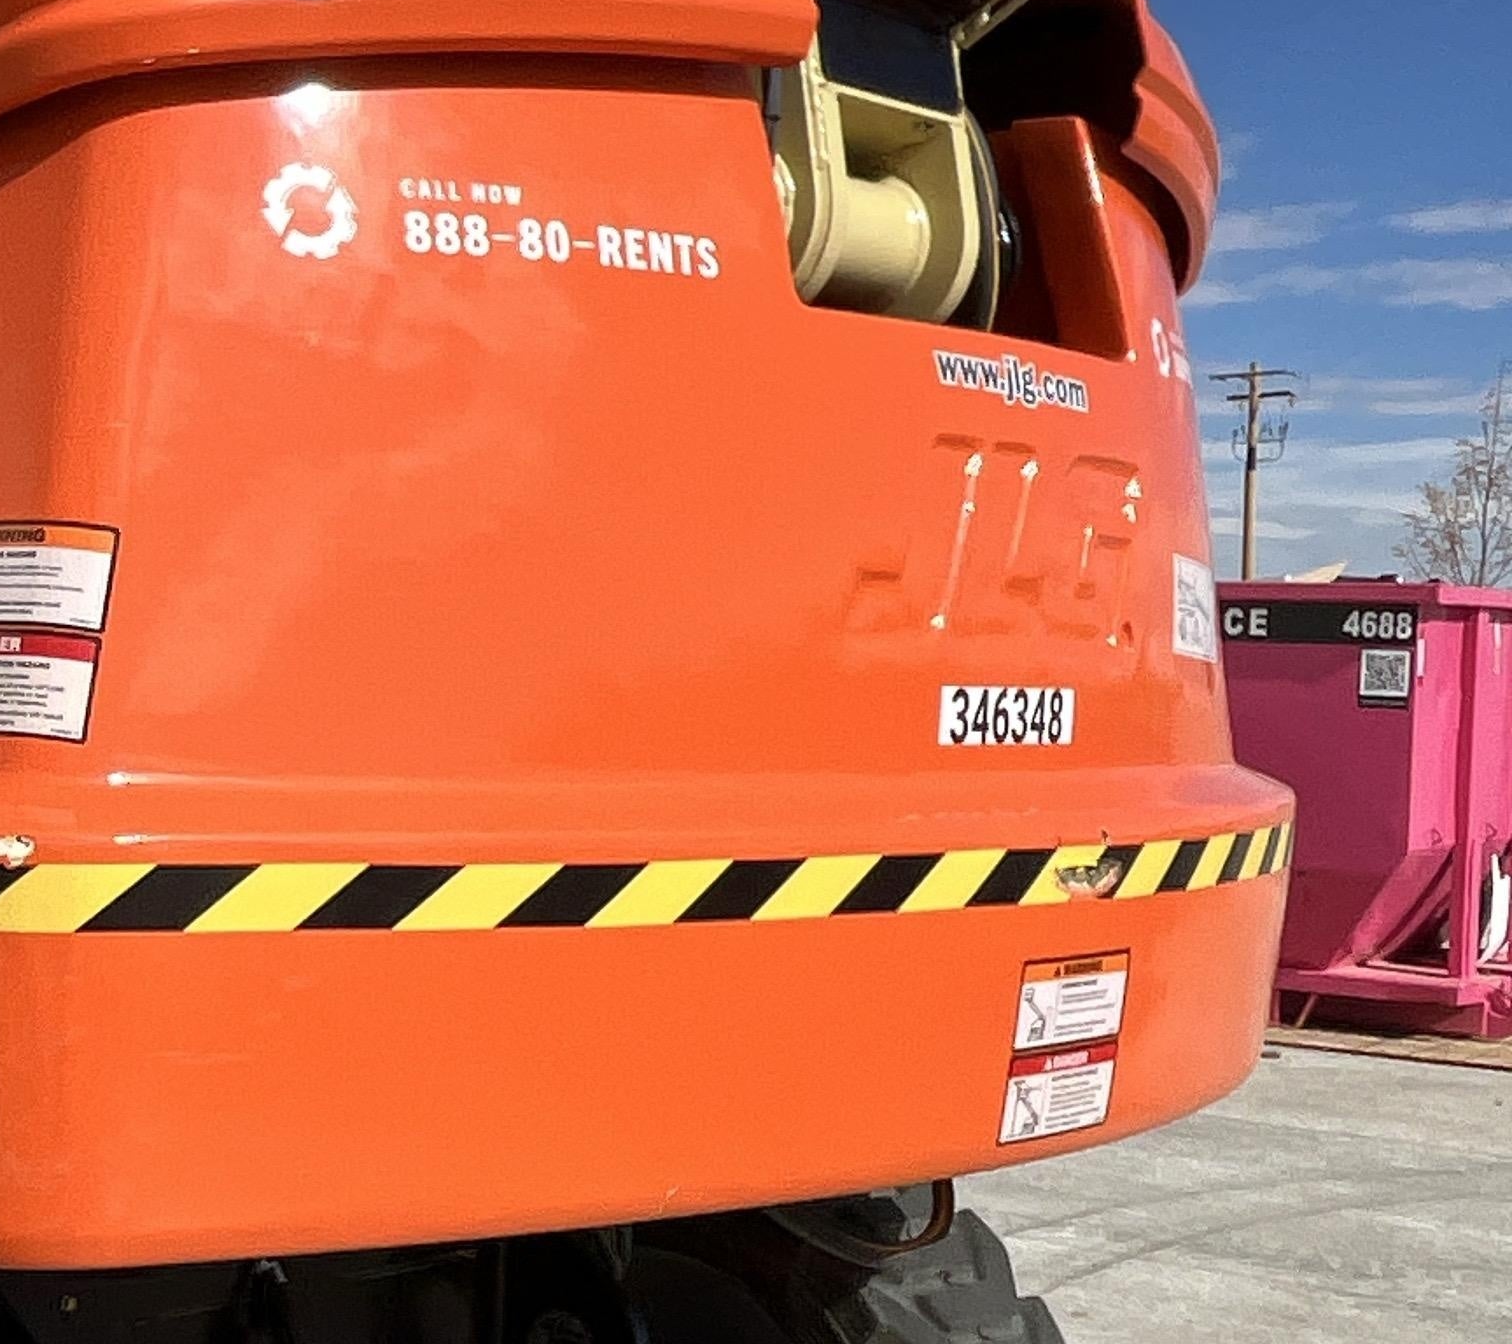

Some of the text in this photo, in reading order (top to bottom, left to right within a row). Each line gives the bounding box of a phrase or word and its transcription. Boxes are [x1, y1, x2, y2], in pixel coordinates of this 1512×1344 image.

[399, 177, 522, 206] CALL NOW
[403, 210, 721, 279] 888-80-RENTS
[937, 354, 1087, 408] www.jlg.com
[1224, 607, 1413, 640] CE 4688
[949, 688, 1063, 745] 346348
